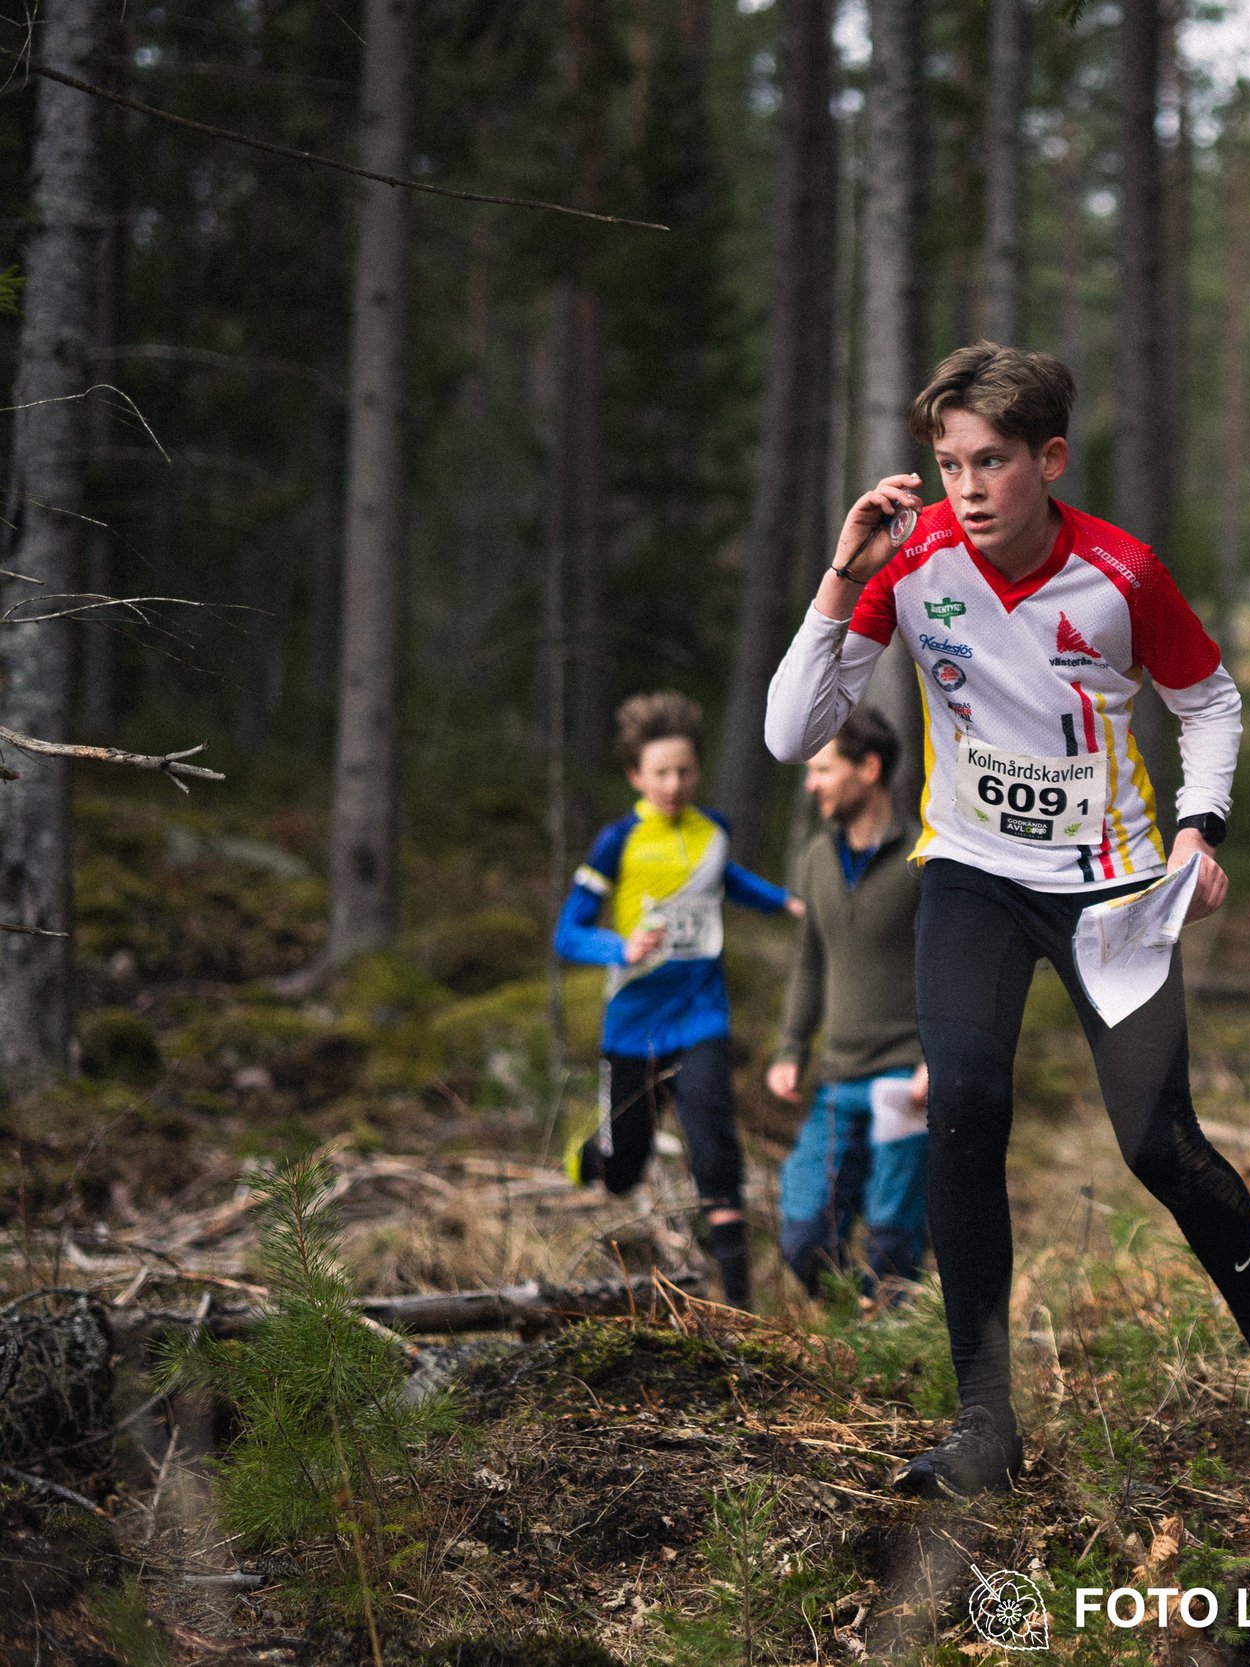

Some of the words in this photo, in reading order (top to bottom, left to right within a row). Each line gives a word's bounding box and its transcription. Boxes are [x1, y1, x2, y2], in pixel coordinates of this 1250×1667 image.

[1091, 546, 1141, 589] noname
[968, 748, 1094, 783] Kolmårdskavlen
[978, 775, 1067, 816] 609
[1077, 799, 1089, 815] 1
[1007, 818, 1048, 829] GODKÄNDA
